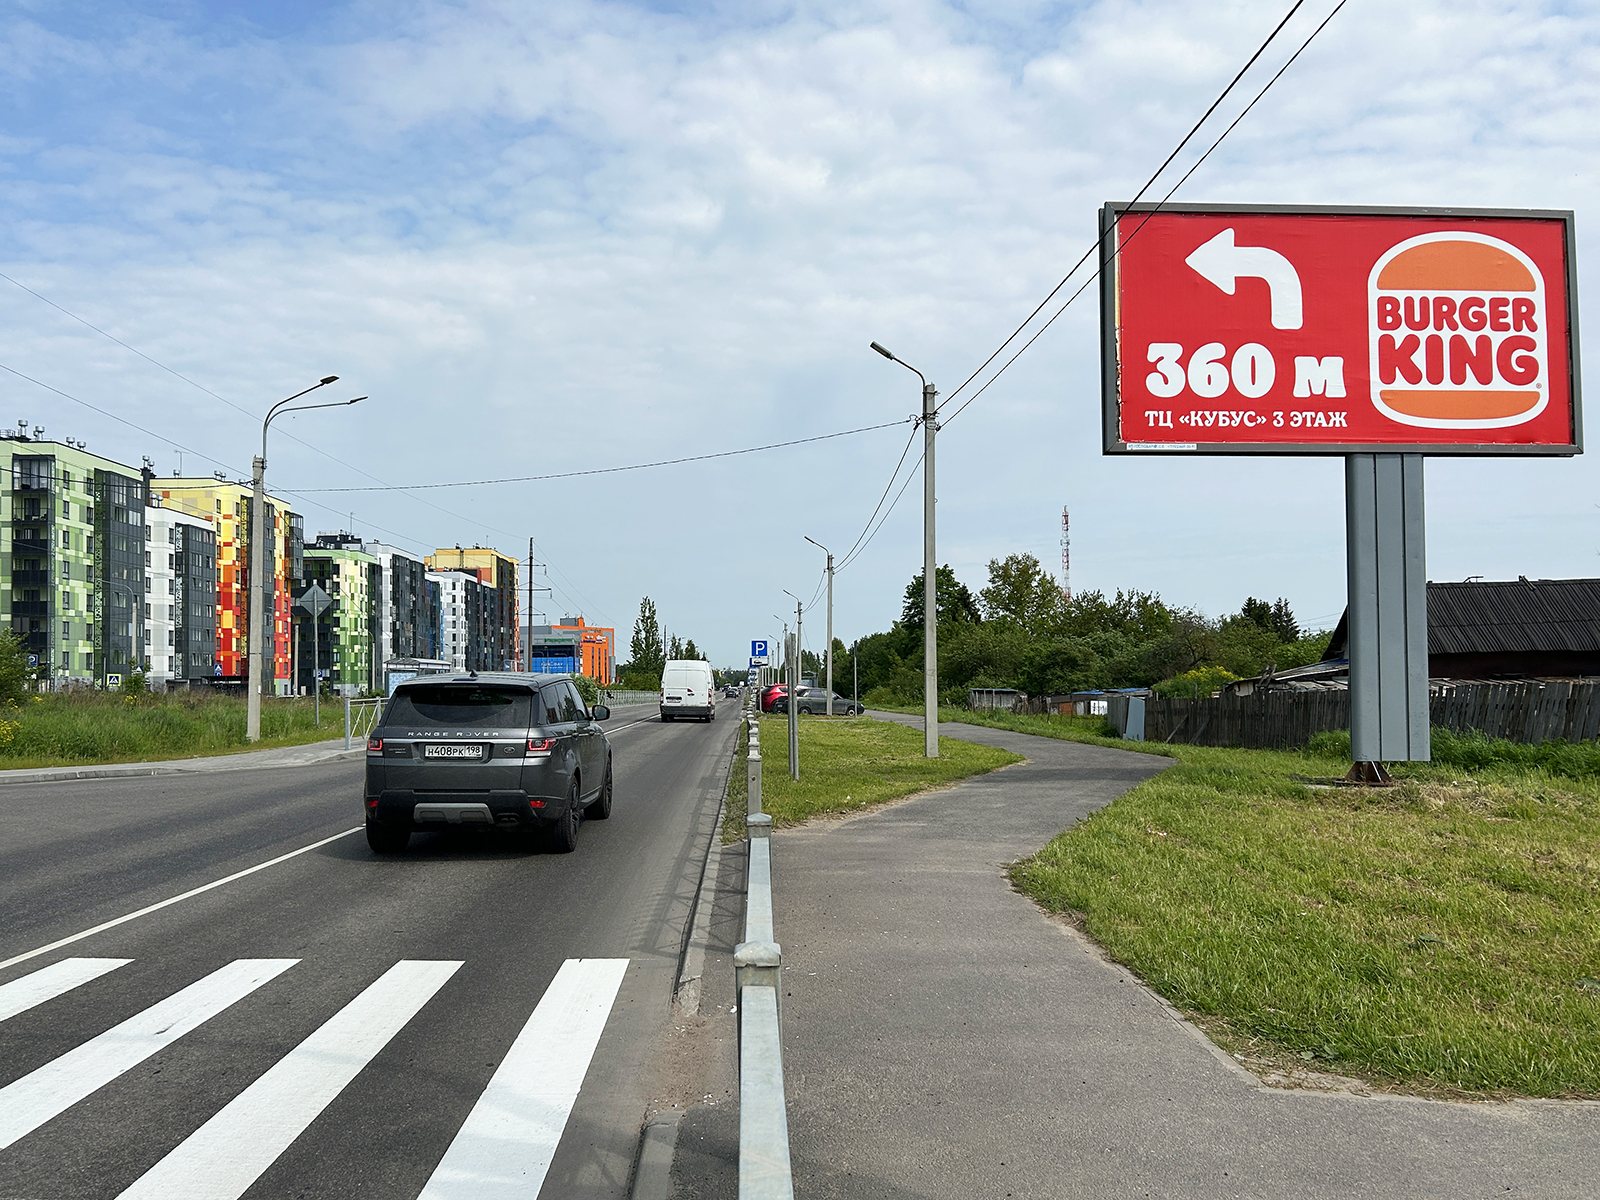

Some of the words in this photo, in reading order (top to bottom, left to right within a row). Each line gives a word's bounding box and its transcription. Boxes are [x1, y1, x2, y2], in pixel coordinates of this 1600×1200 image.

[1377, 296, 1538, 333] BURGER
[1145, 342, 1276, 399] 360
[1378, 333, 1540, 386] KING
[1144, 410, 1174, 429] ТЦ
[1178, 410, 1267, 428] «КУБУС»
[1272, 410, 1285, 428] 3
[1289, 410, 1348, 428] ЭТАЖ
[466, 746, 481, 754] 198
